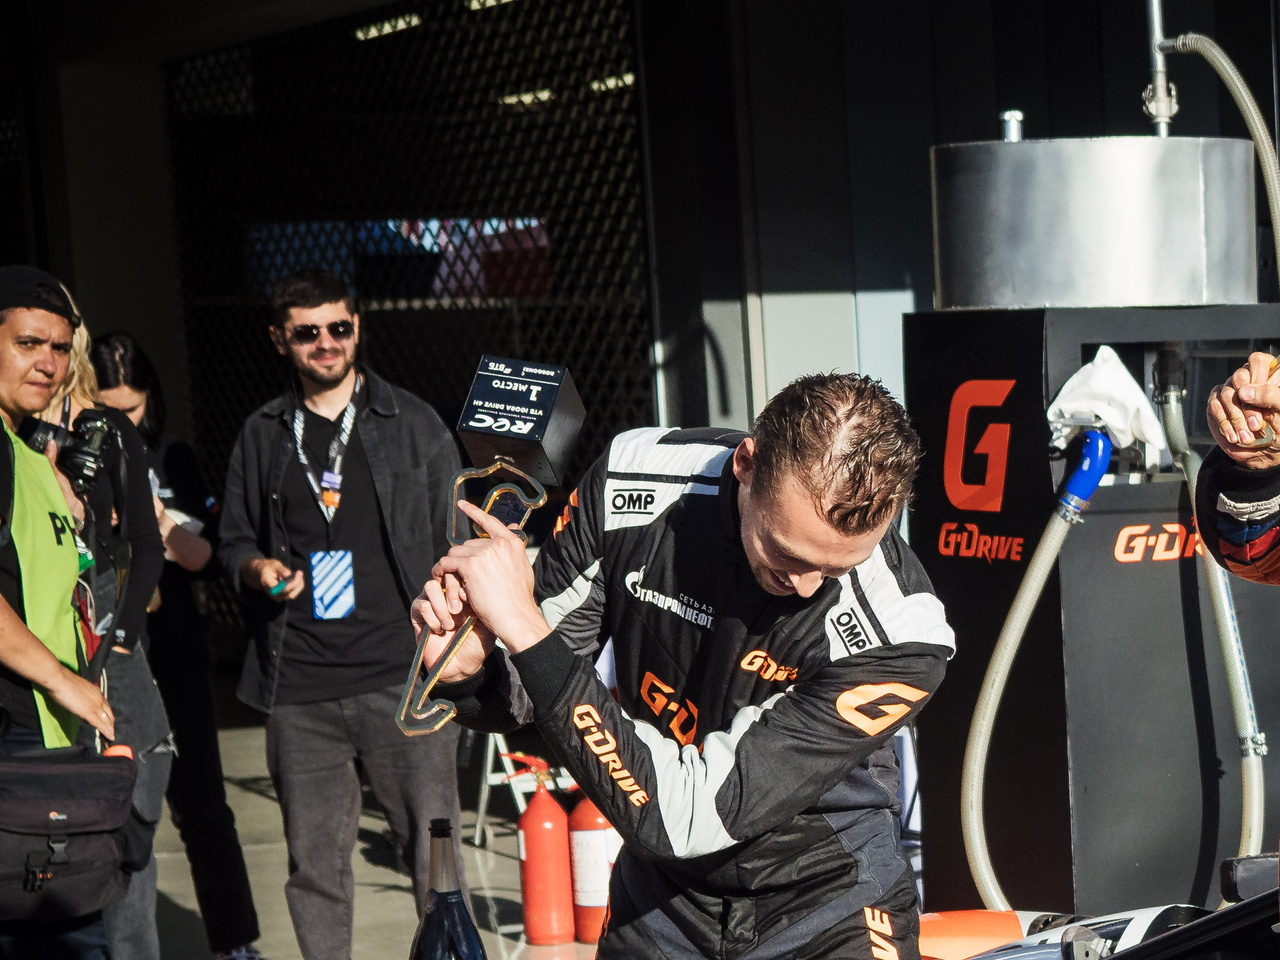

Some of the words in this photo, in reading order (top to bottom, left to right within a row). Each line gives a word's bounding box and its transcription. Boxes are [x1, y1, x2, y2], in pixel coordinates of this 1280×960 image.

[488, 362, 505, 372] ВТБ
[492, 379, 529, 392] МЕСТО
[530, 385, 542, 401] 1
[484, 401, 506, 411] DRIVE
[530, 408, 543, 416] VTB
[943, 379, 1017, 513] G
[611, 492, 656, 511] OMP
[679, 592, 701, 607] СЕТЬ
[640, 587, 714, 630] ГАЗПРОМНЕФТ
[836, 611, 868, 651] OMP
